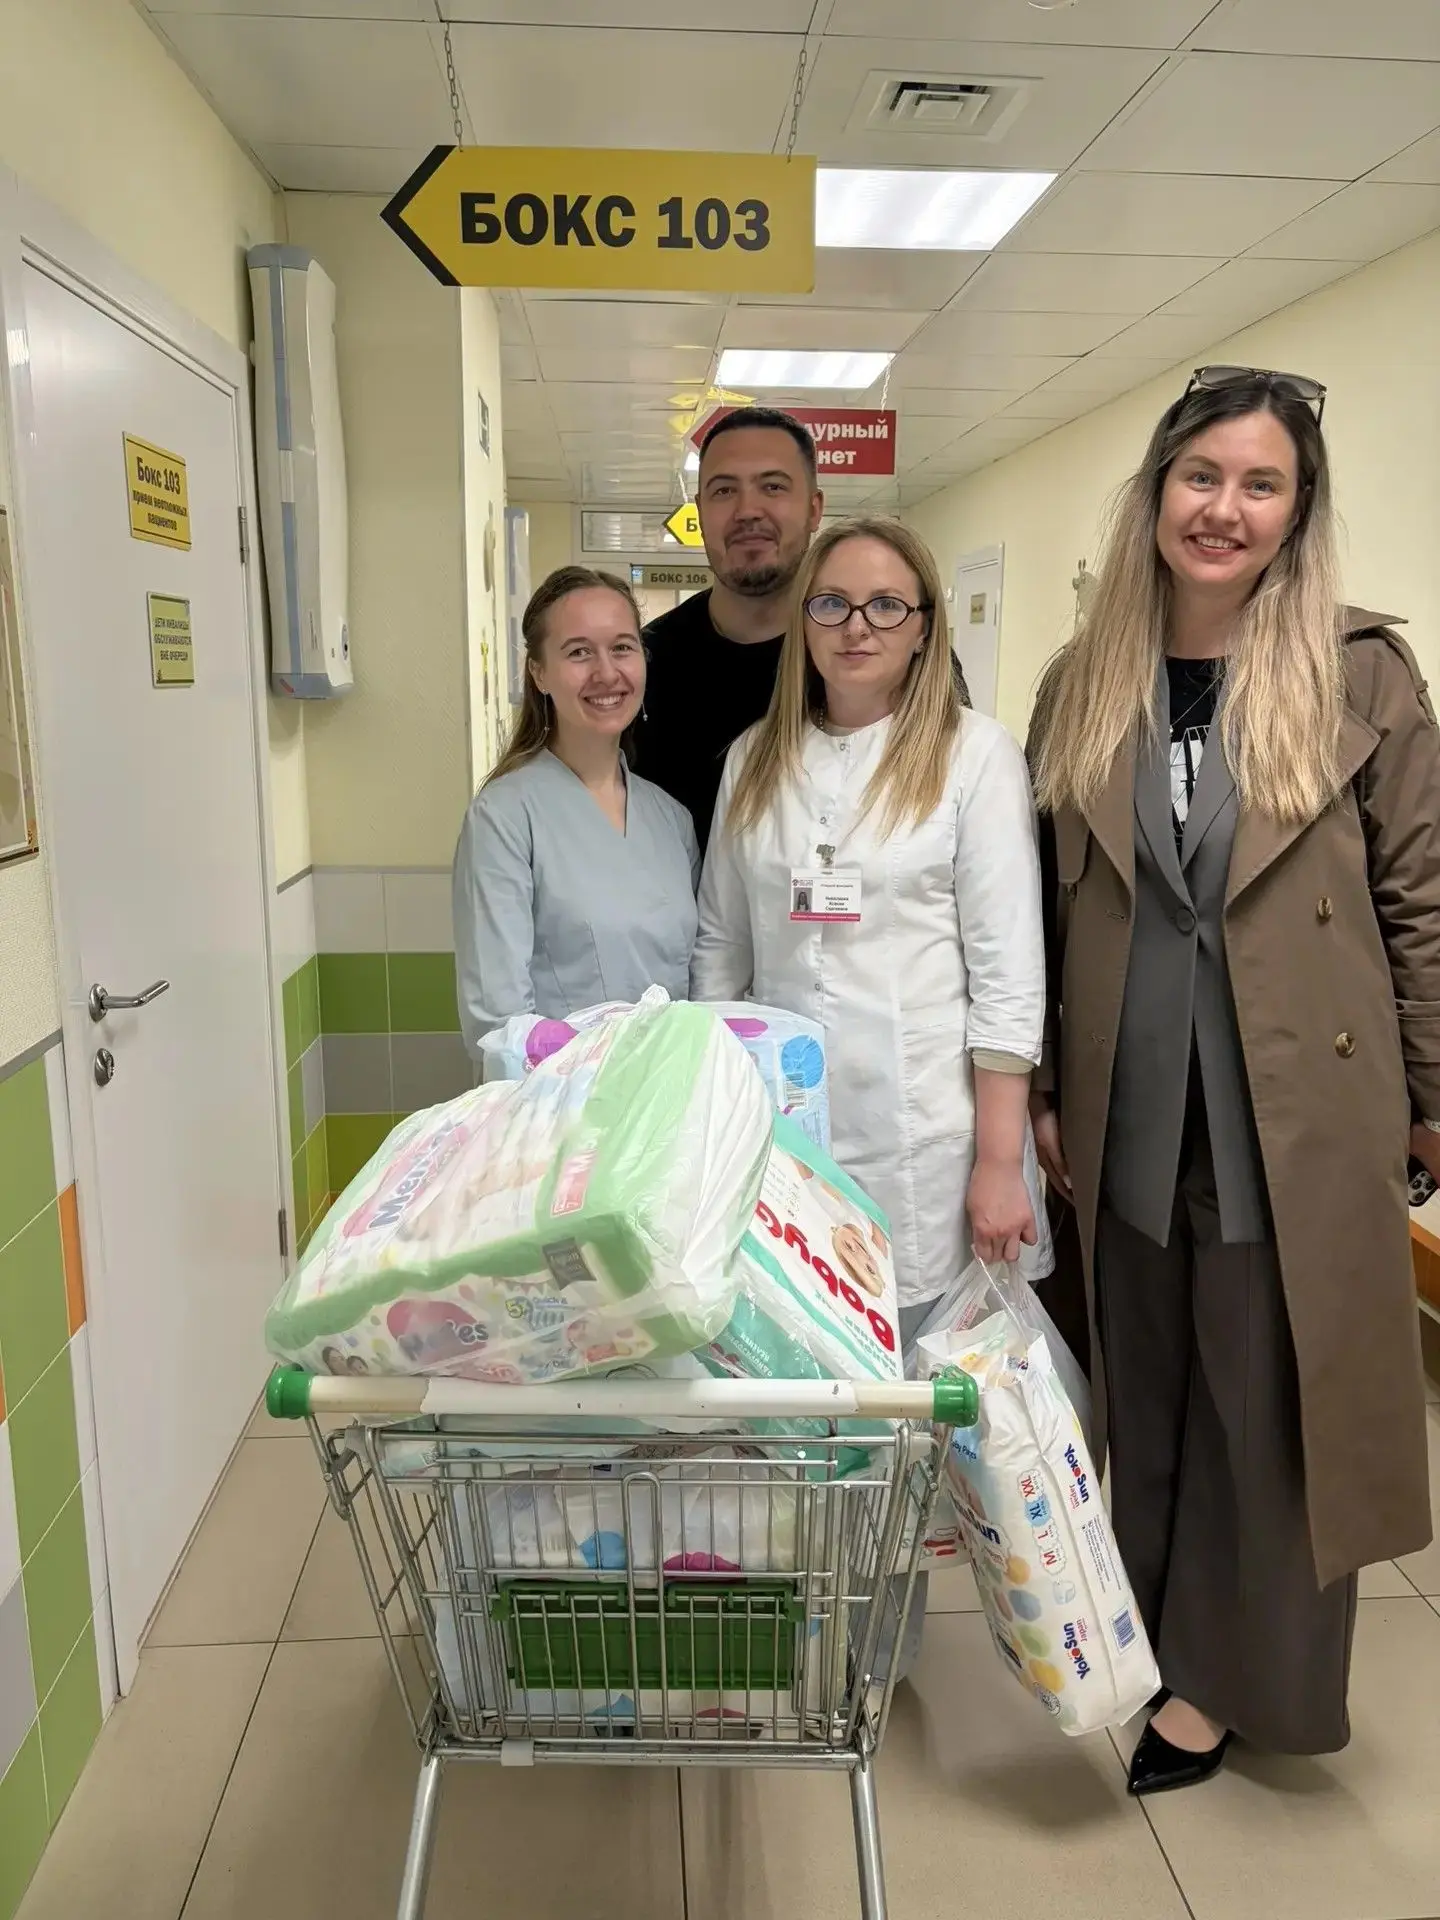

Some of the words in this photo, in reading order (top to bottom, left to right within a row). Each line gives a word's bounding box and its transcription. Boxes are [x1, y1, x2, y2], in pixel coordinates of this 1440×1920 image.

[460, 192, 636, 247] БОКС
[657, 196, 771, 251] 103
[817, 449, 857, 465] нет
[136, 455, 162, 489] Бокс
[163, 468, 180, 495] 103
[650, 573, 683, 583] БОКС
[686, 574, 708, 584] 106
[755, 1199, 895, 1352] BabyG
[1064, 1443, 1090, 1504] YokoSun
[1021, 1475, 1036, 1498] XXL
[1069, 1484, 1080, 1508] Japan
[1029, 1503, 1043, 1521] XL
[1038, 1530, 1049, 1540] L
[1043, 1550, 1057, 1566] M
[1076, 1618, 1088, 1642] Japan
[1063, 1622, 1091, 1680] YokoSun
